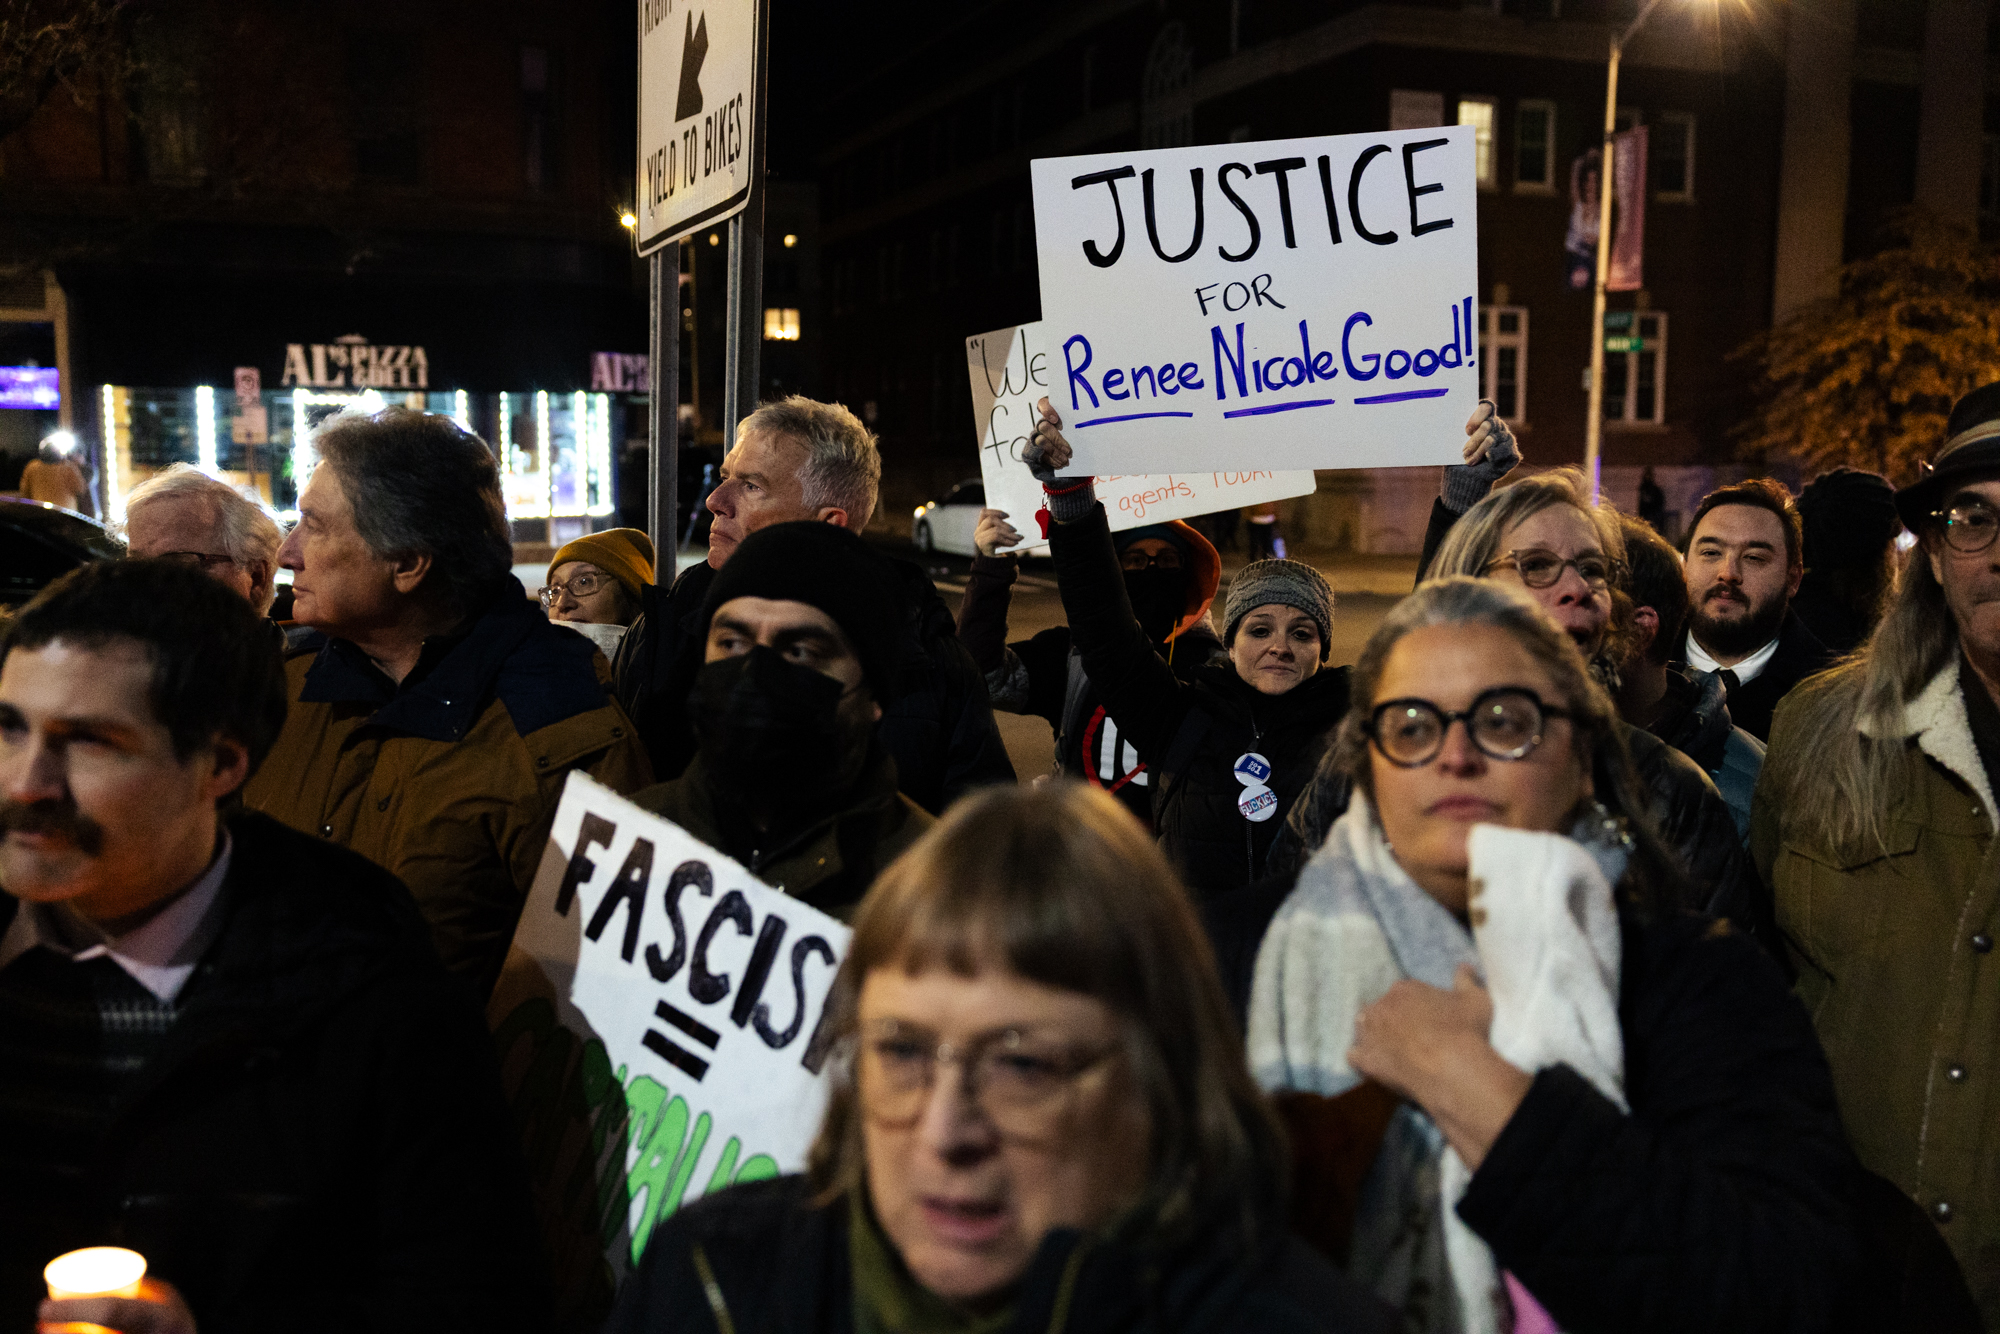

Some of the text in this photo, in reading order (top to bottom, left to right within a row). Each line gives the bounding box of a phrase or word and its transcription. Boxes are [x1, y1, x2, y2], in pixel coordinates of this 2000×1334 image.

[647, 92, 743, 210] YIELD TO BIKES
[1071, 137, 1454, 268] JUSTICE
[1194, 273, 1287, 317] FOR
[350, 345, 428, 365] PIZZA
[1062, 296, 1476, 412] Renee Nicole Good!
[1118, 475, 1197, 519] agents,
